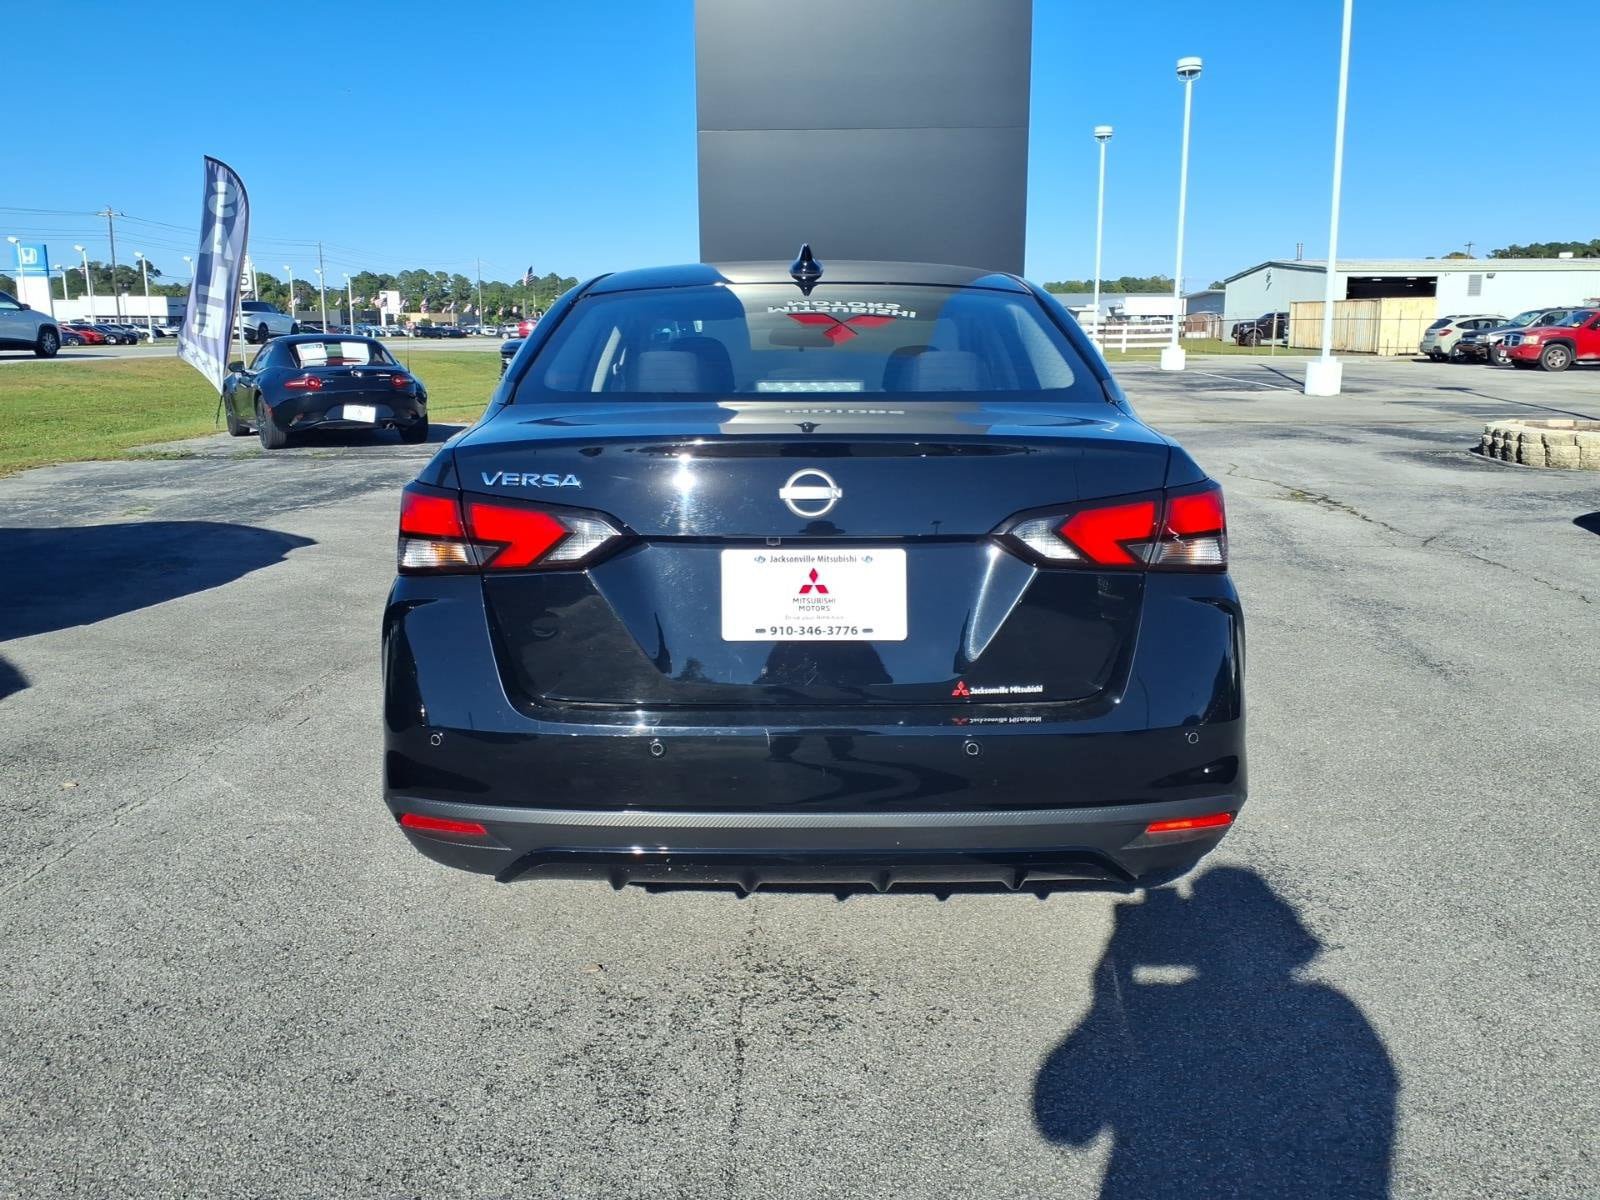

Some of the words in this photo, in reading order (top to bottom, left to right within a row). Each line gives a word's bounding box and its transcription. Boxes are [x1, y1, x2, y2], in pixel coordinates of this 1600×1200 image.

[481, 471, 582, 488] VERSA
[769, 555, 815, 564] Jacksonville
[817, 555, 857, 564] Mitsubishi
[792, 597, 836, 605] MITSUBISHI
[769, 625, 859, 636] 910-346-3776
[970, 686, 1009, 695] Jacksonville
[1009, 684, 1043, 694] Mitsubishi
